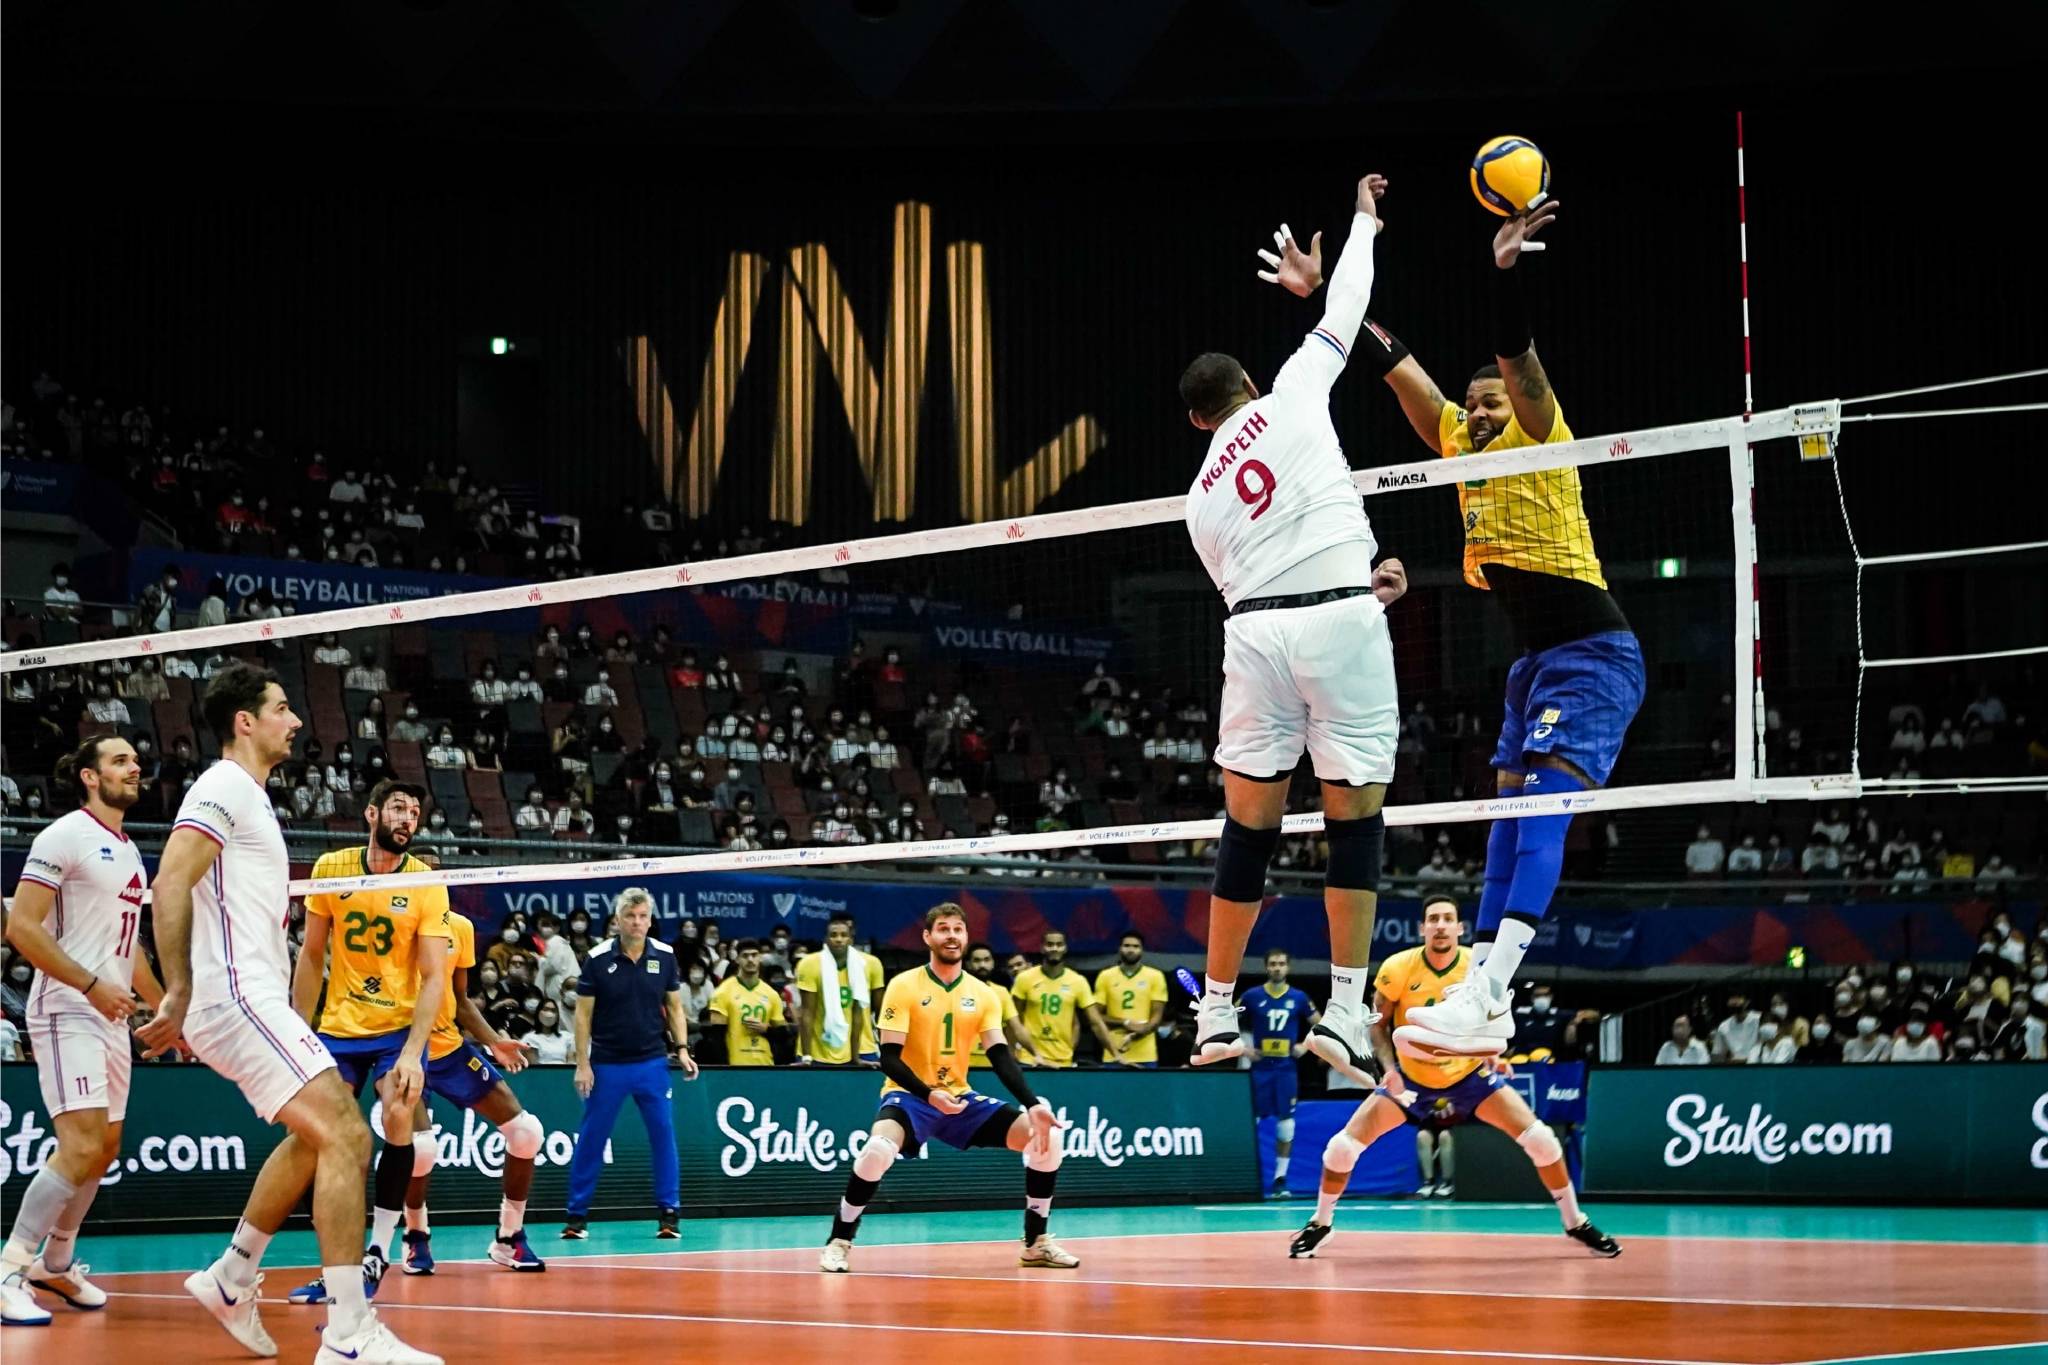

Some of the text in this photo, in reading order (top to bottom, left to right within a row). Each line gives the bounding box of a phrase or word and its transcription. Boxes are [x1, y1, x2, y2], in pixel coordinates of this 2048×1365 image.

[617, 200, 1107, 527] VNL
[1201, 412, 1269, 494] NGAPETH
[1610, 438, 1633, 457] VNL
[1235, 459, 1277, 521] 9
[1007, 522, 1025, 539] VNL
[835, 545, 850, 562] VNL
[676, 567, 692, 583] VNL
[527, 587, 543, 602] VNL
[935, 626, 1071, 657] VOLLEYBALL
[697, 892, 755, 905] NATIONS
[697, 906, 748, 919] LEAGUE
[115, 912, 136, 958] 11
[344, 911, 395, 956] 23
[1040, 992, 1061, 1016] 18
[1122, 990, 1135, 1010] 2
[941, 1012, 955, 1049] 1
[1267, 1008, 1290, 1032] 17
[76, 1076, 89, 1095] 11
[717, 1096, 929, 1177] Stake.c
[1019, 1095, 1204, 1167] take.com
[1664, 1093, 1893, 1167] Stake.com
